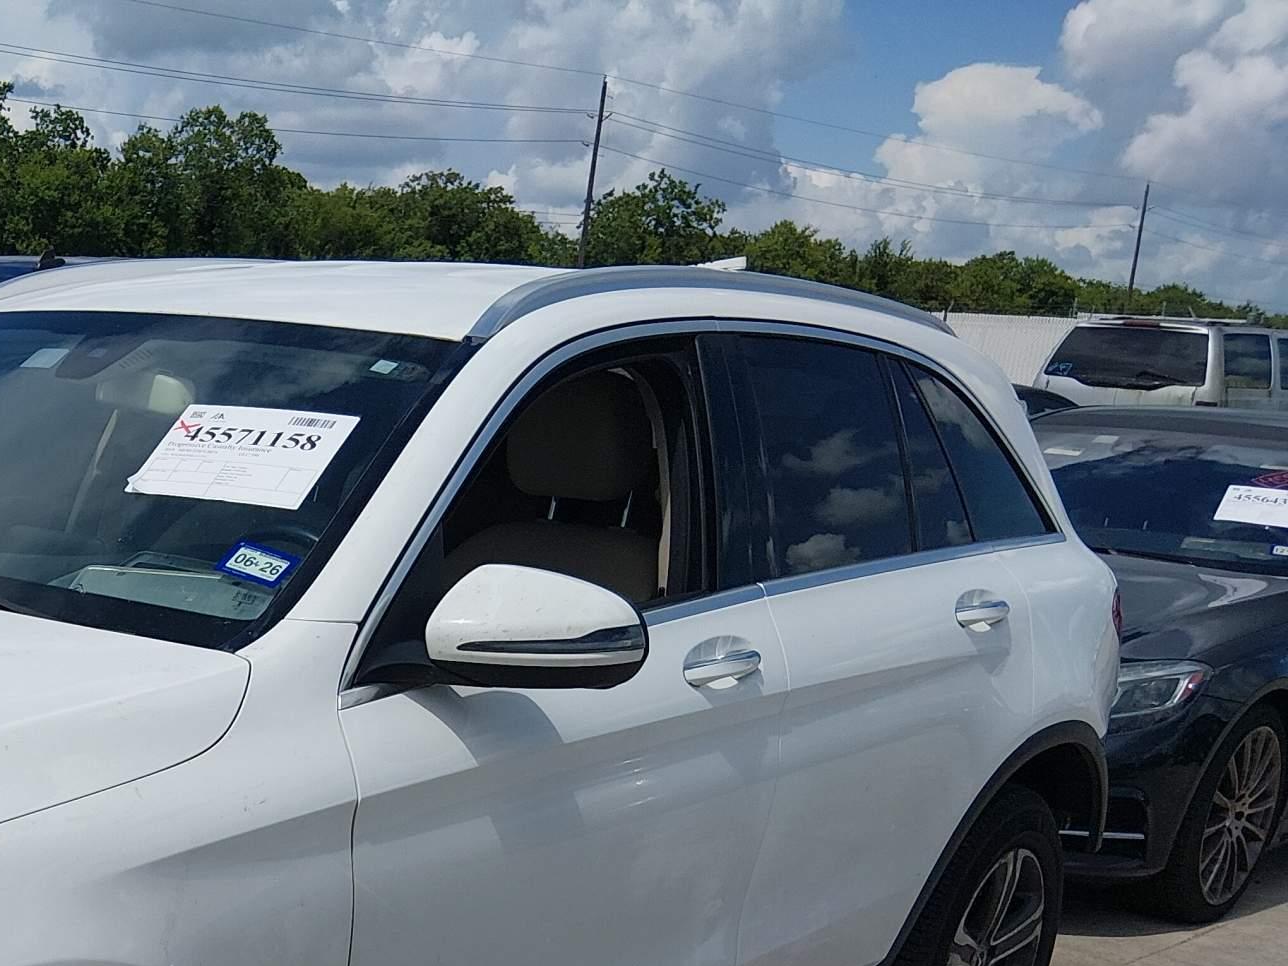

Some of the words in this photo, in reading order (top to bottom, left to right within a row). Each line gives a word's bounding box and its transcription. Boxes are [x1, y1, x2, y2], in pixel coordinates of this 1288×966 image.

[184, 426, 322, 451] 45571158
[234, 553, 257, 567] 06
[259, 562, 283, 576] 26
